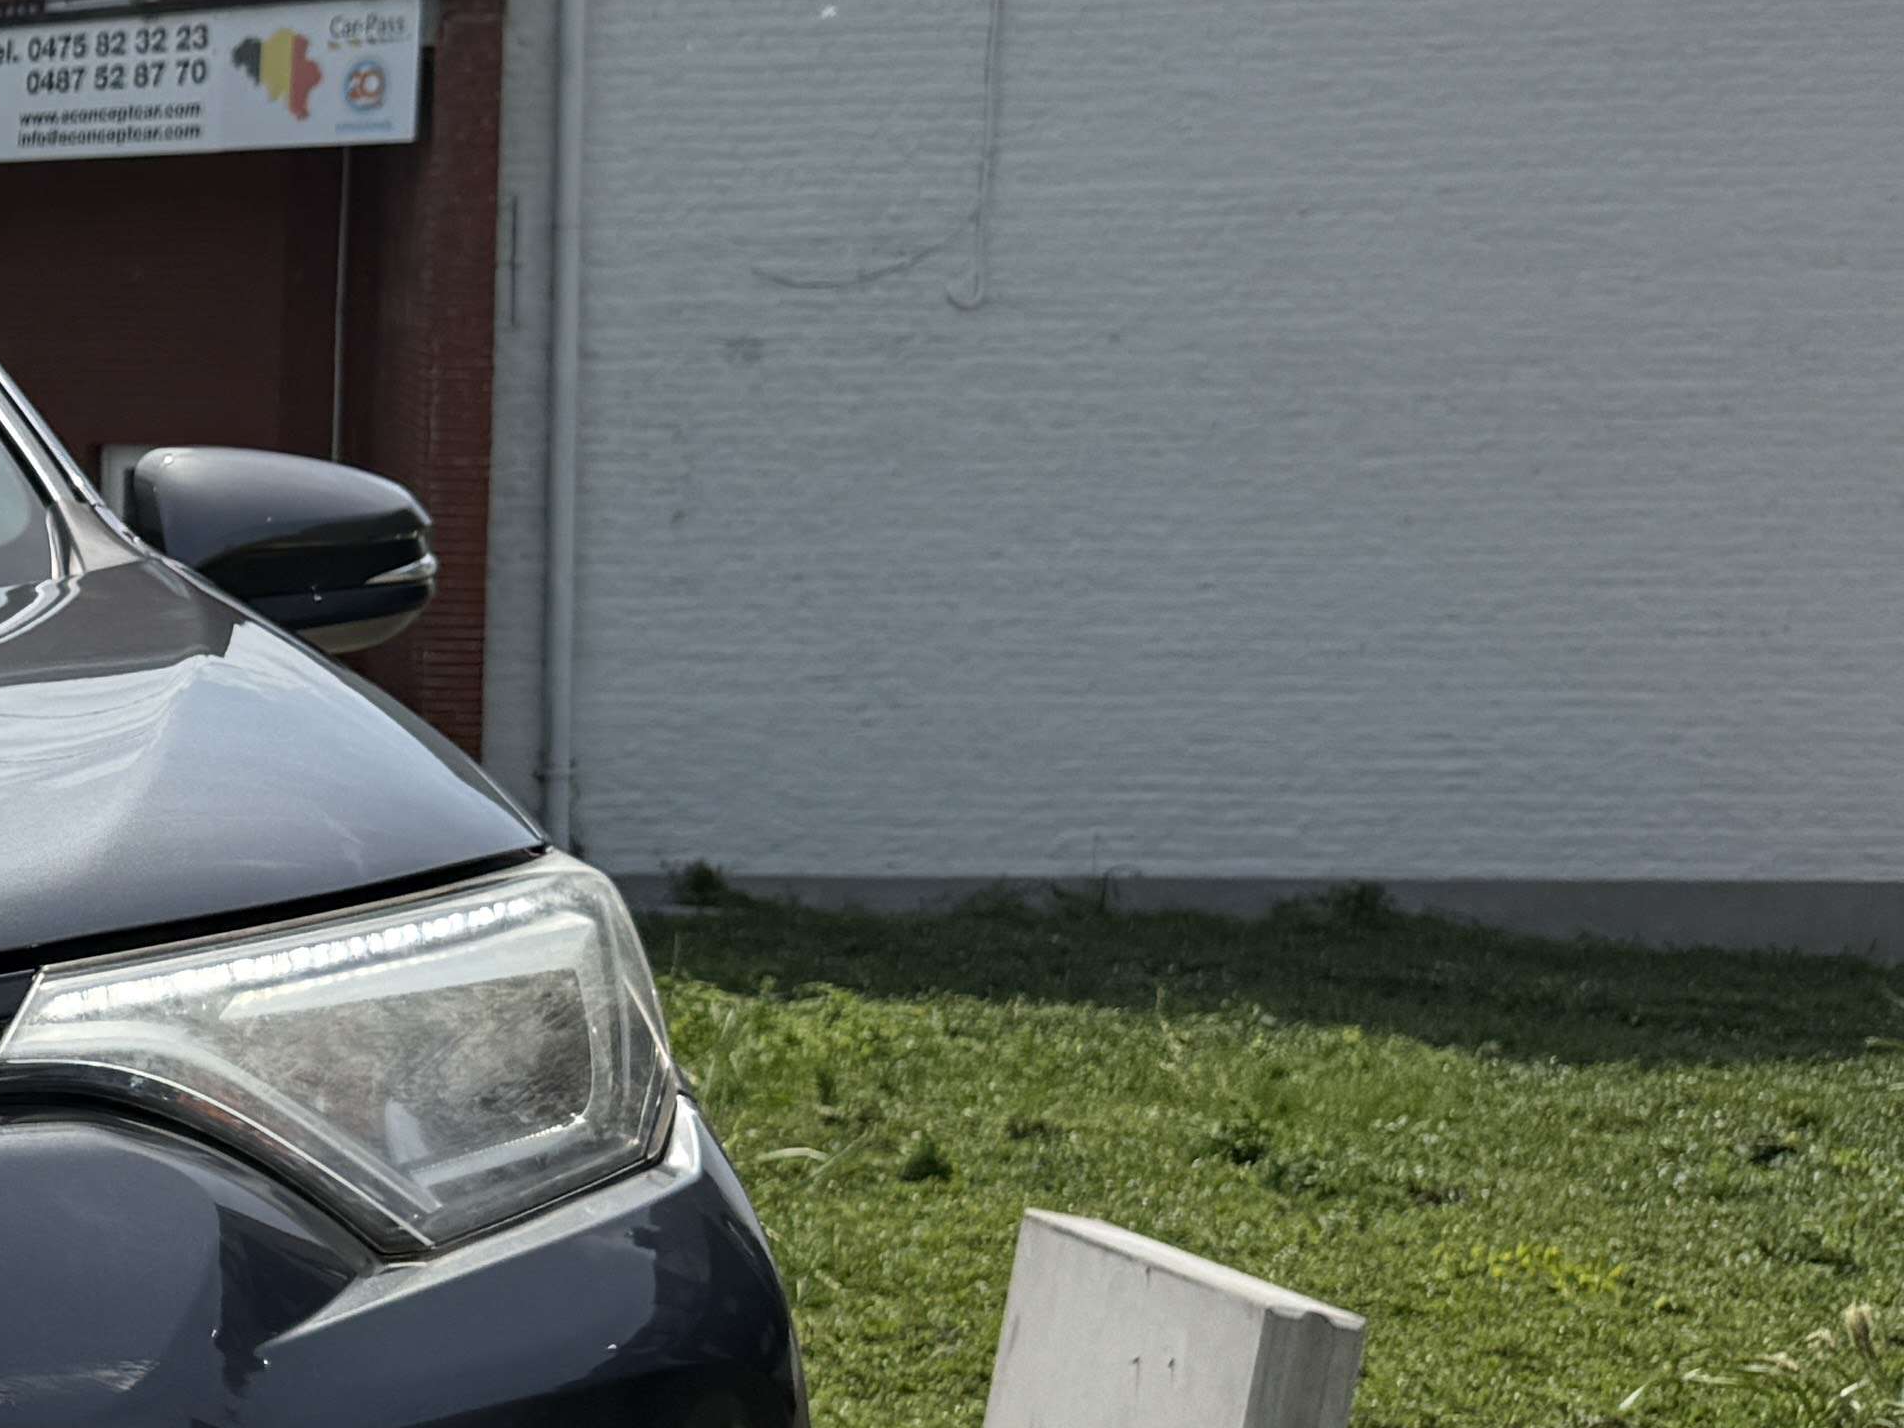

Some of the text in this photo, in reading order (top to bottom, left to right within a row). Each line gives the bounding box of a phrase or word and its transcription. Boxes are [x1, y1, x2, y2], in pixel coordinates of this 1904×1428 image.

[27, 33, 88, 62] 0475
[95, 30, 126, 57] 82
[135, 27, 168, 54] 32
[176, 24, 210, 50] 23
[26, 58, 207, 95] 0487 52 87 70
[19, 103, 201, 127] www.econceptcar.com
[18, 125, 201, 149] info@econceptcar.com
